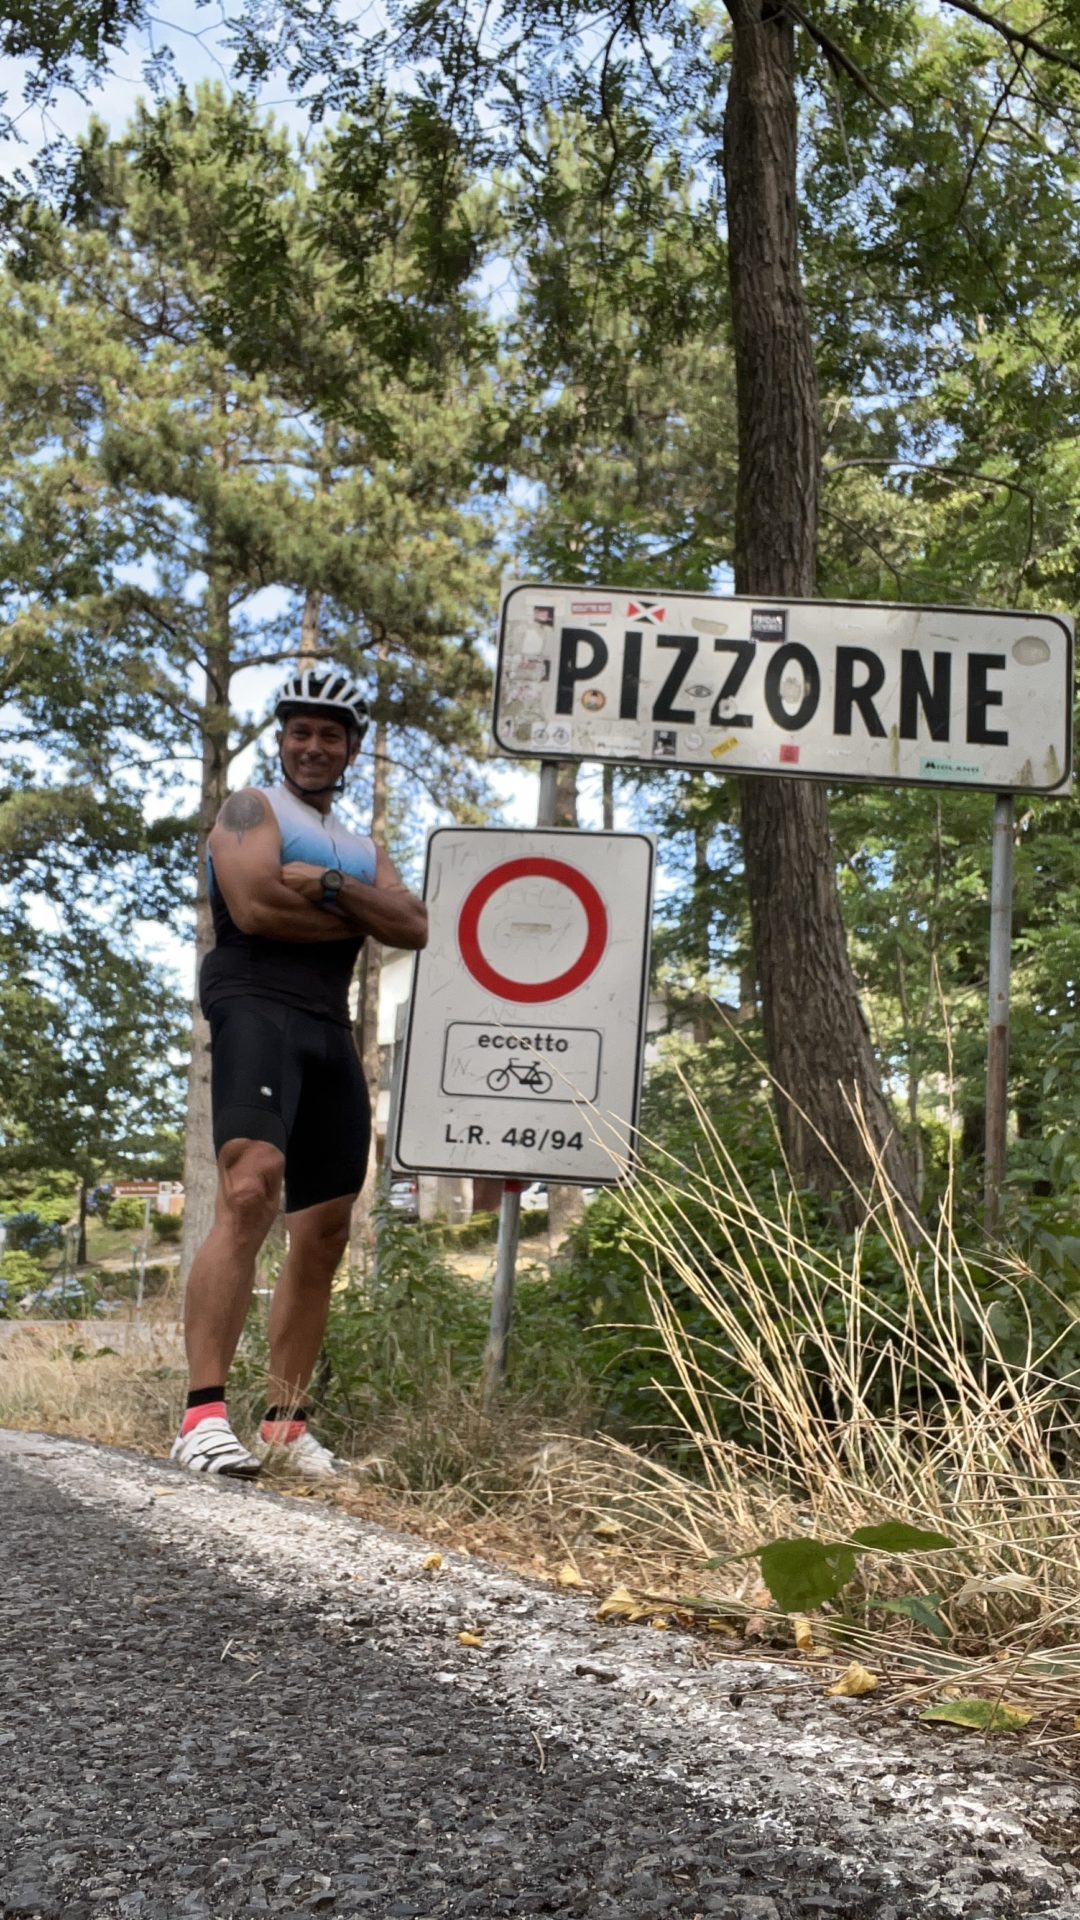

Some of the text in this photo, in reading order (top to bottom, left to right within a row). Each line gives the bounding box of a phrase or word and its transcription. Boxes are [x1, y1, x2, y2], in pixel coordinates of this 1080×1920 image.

[555, 627, 1009, 746] PIZZORNE
[478, 1033, 569, 1053] eccetto
[445, 1124, 584, 1151] L.R. 48/94
